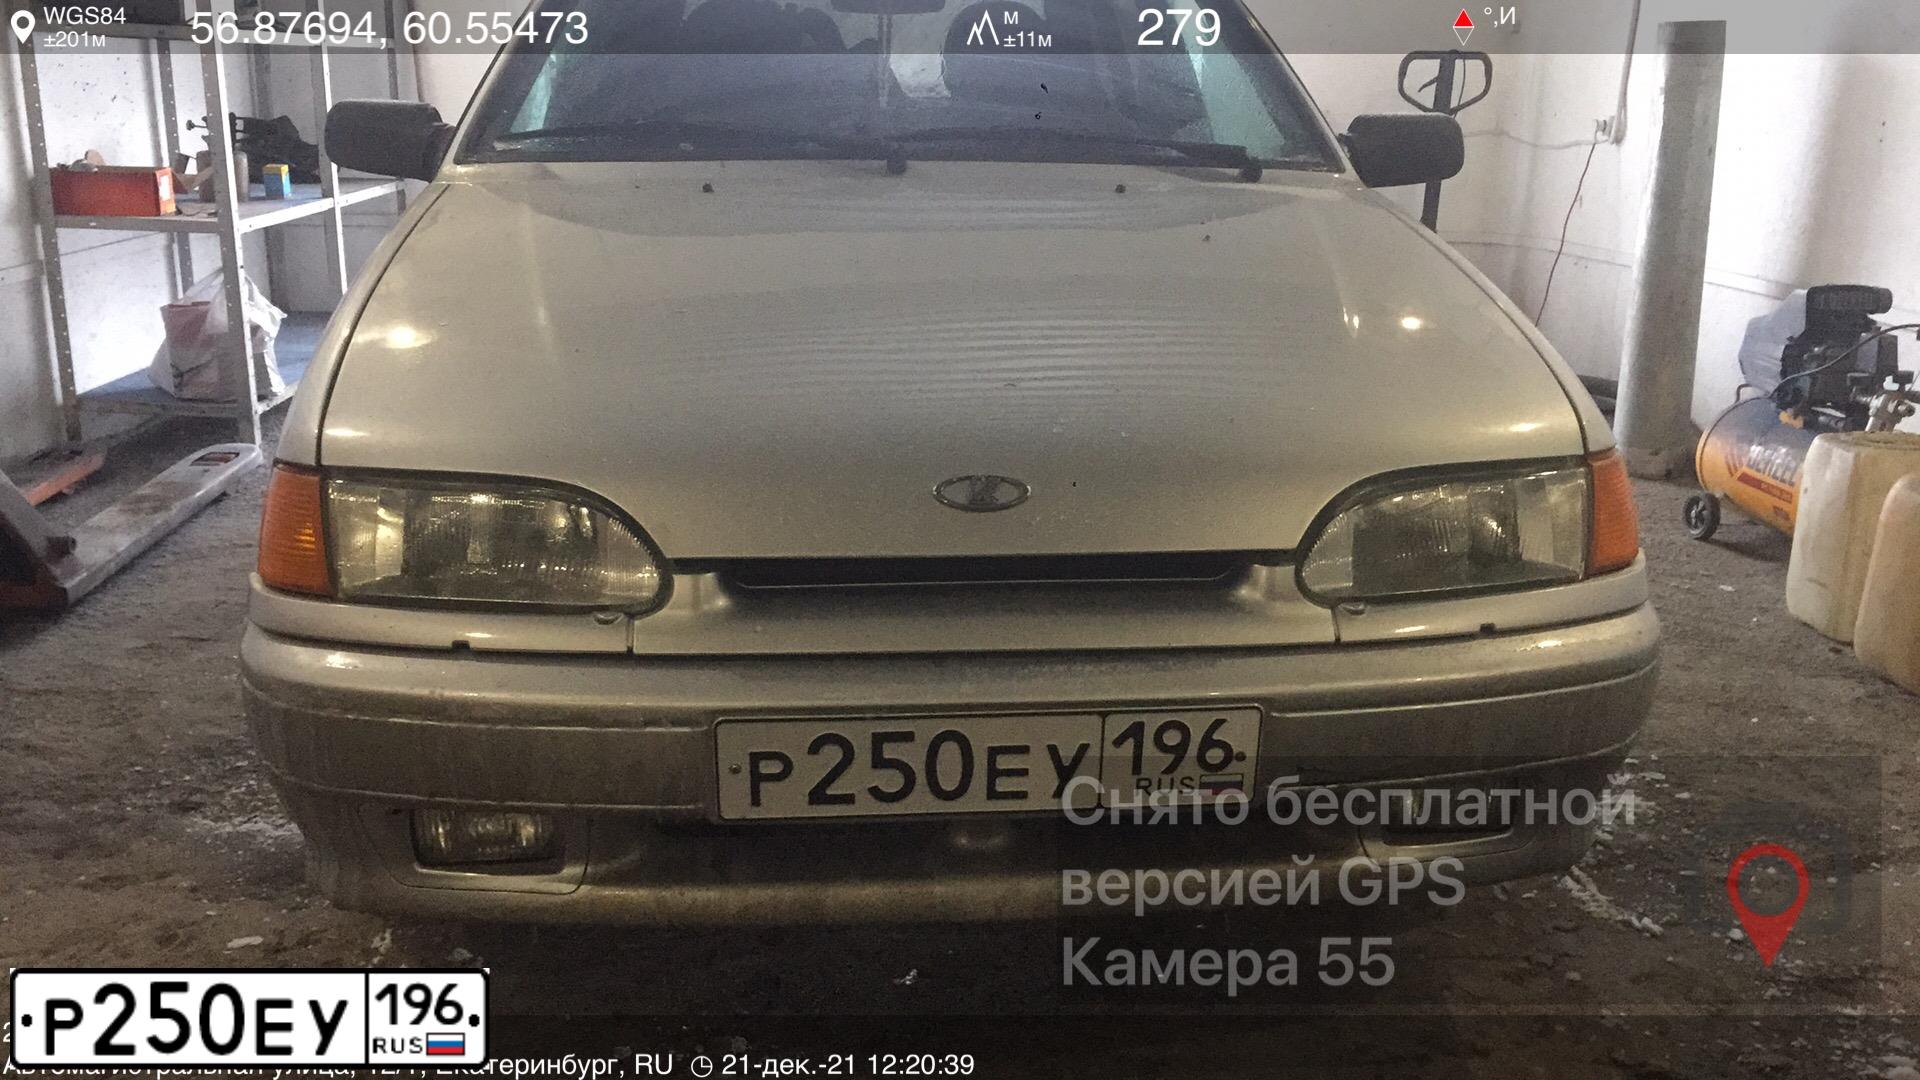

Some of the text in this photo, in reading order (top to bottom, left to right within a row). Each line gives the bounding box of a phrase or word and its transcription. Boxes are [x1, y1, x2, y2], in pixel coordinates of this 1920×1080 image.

[748, 718, 1236, 808] Р250ЕУ 196
[1135, 775, 1196, 797] RUS
